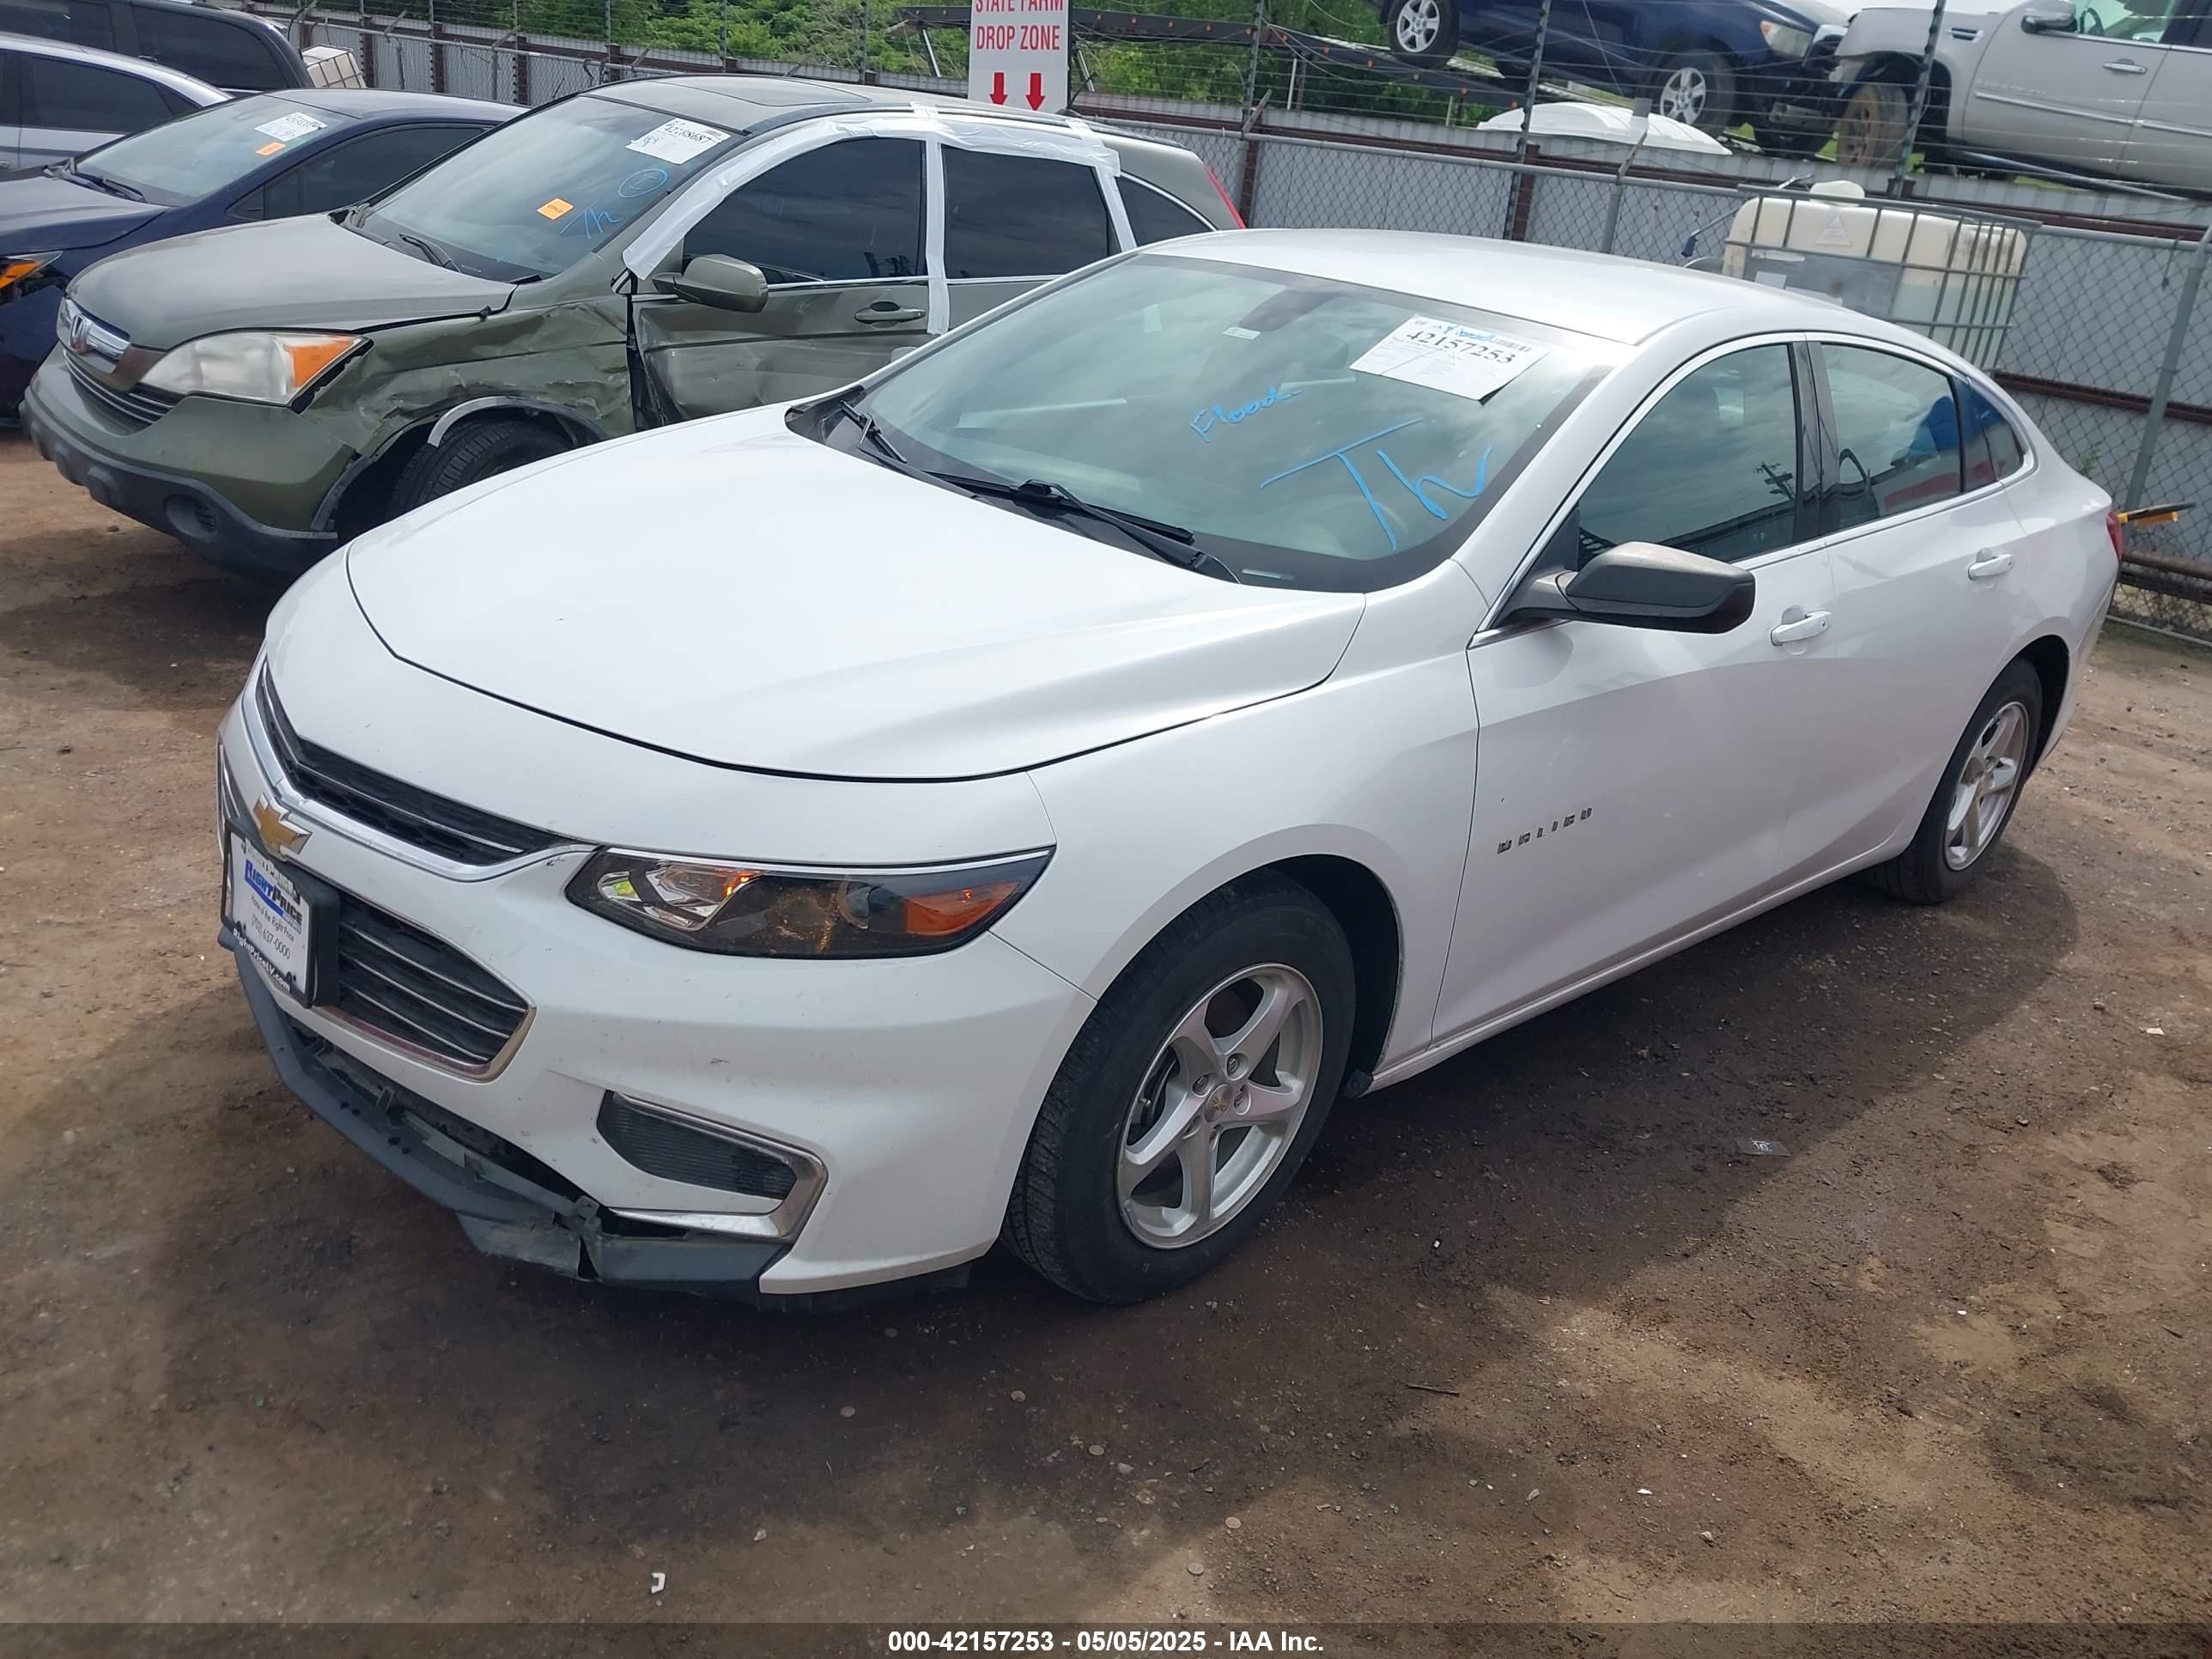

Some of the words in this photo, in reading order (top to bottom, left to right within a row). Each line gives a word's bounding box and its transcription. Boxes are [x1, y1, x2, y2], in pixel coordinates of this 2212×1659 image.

[976, 25, 1015, 50] DROP
[1020, 25, 1060, 50] ZONE
[1407, 330, 1516, 365] 42157253
